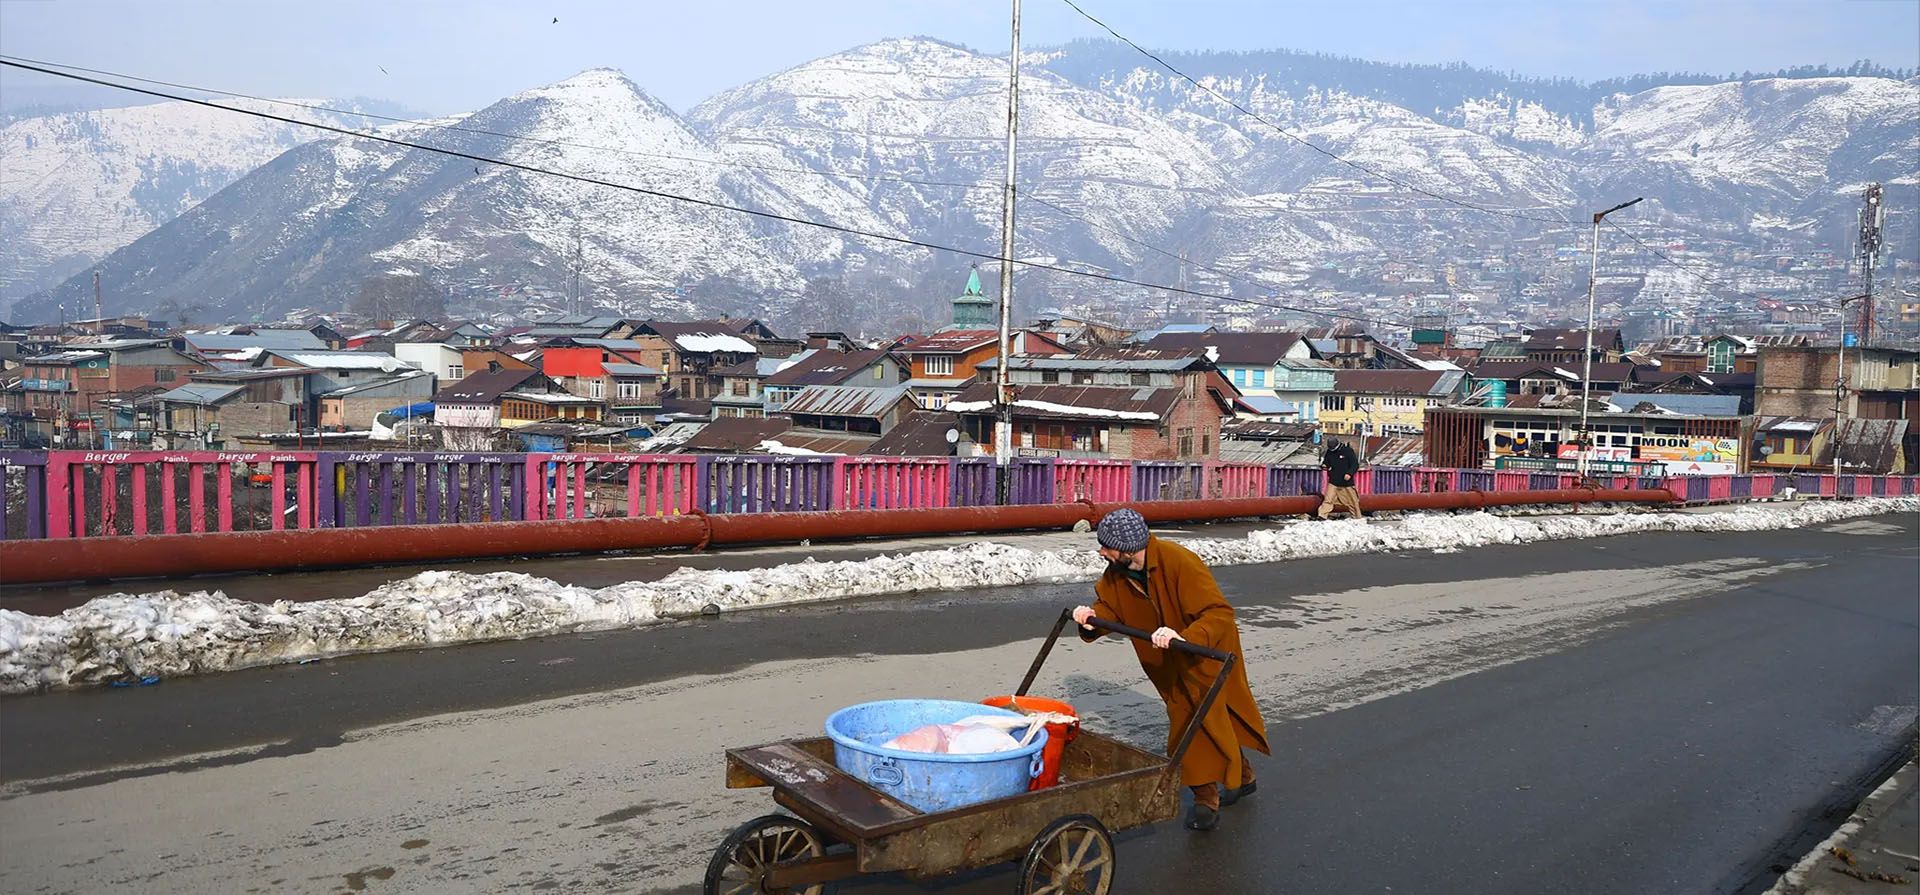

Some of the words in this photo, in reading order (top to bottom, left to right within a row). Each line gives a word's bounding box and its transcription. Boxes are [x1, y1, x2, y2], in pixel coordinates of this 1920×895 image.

[1641, 438, 1689, 448] MOON
[85, 452, 131, 464] Berger
[217, 452, 257, 462] Berger
[348, 452, 382, 462] Berger
[433, 453, 464, 462] Berger
[551, 454, 578, 462] Berger
